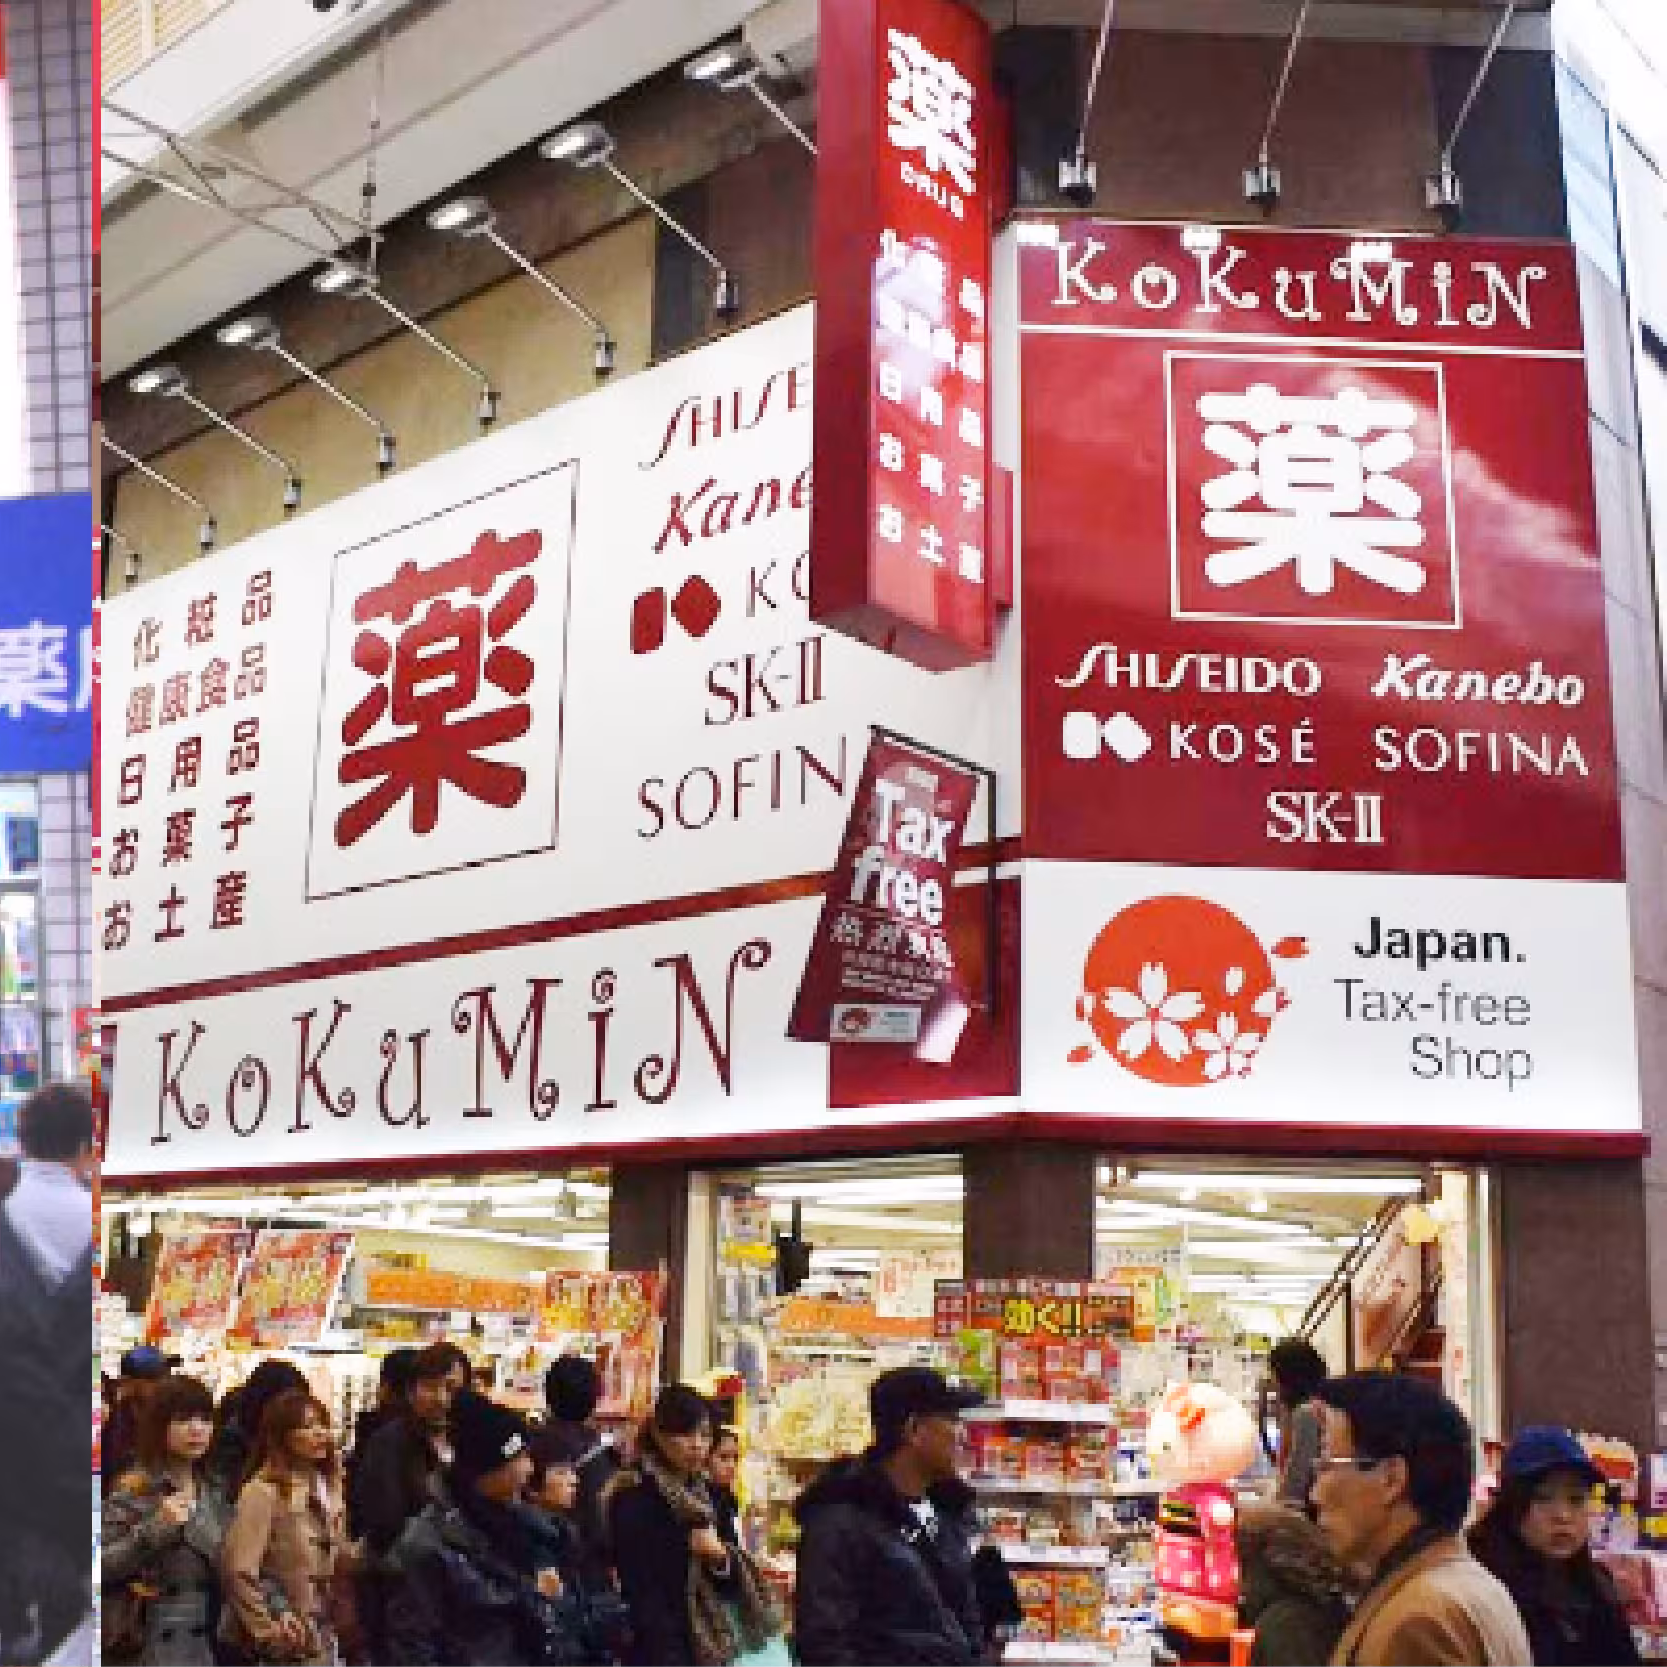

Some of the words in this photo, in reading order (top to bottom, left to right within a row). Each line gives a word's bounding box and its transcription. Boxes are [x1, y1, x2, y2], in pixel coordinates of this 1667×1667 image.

[886, 28, 978, 194] 薬
[638, 358, 812, 472] SHISE
[653, 460, 812, 554] Kane
[1196, 383, 1429, 596] 薬
[132, 569, 274, 671] 化粧品
[124, 644, 267, 738] 健康食品
[334, 528, 543, 849] 薬
[1055, 643, 1323, 698] SHISEIDO
[1370, 654, 1587, 707] Kanebo
[118, 716, 261, 806] 日用品
[636, 734, 849, 841] SOFIN
[1169, 718, 1316, 765] KOSÉ
[1374, 728, 1590, 777] SOFINA
[109, 794, 255, 880] お菓子
[871, 779, 953, 866] Tax
[102, 869, 247, 953] お土産
[850, 844, 944, 925] free
[1352, 917, 1528, 974] Japan.
[1333, 978, 1533, 1028] Tax-free
[1410, 1034, 1534, 1093] Shop
